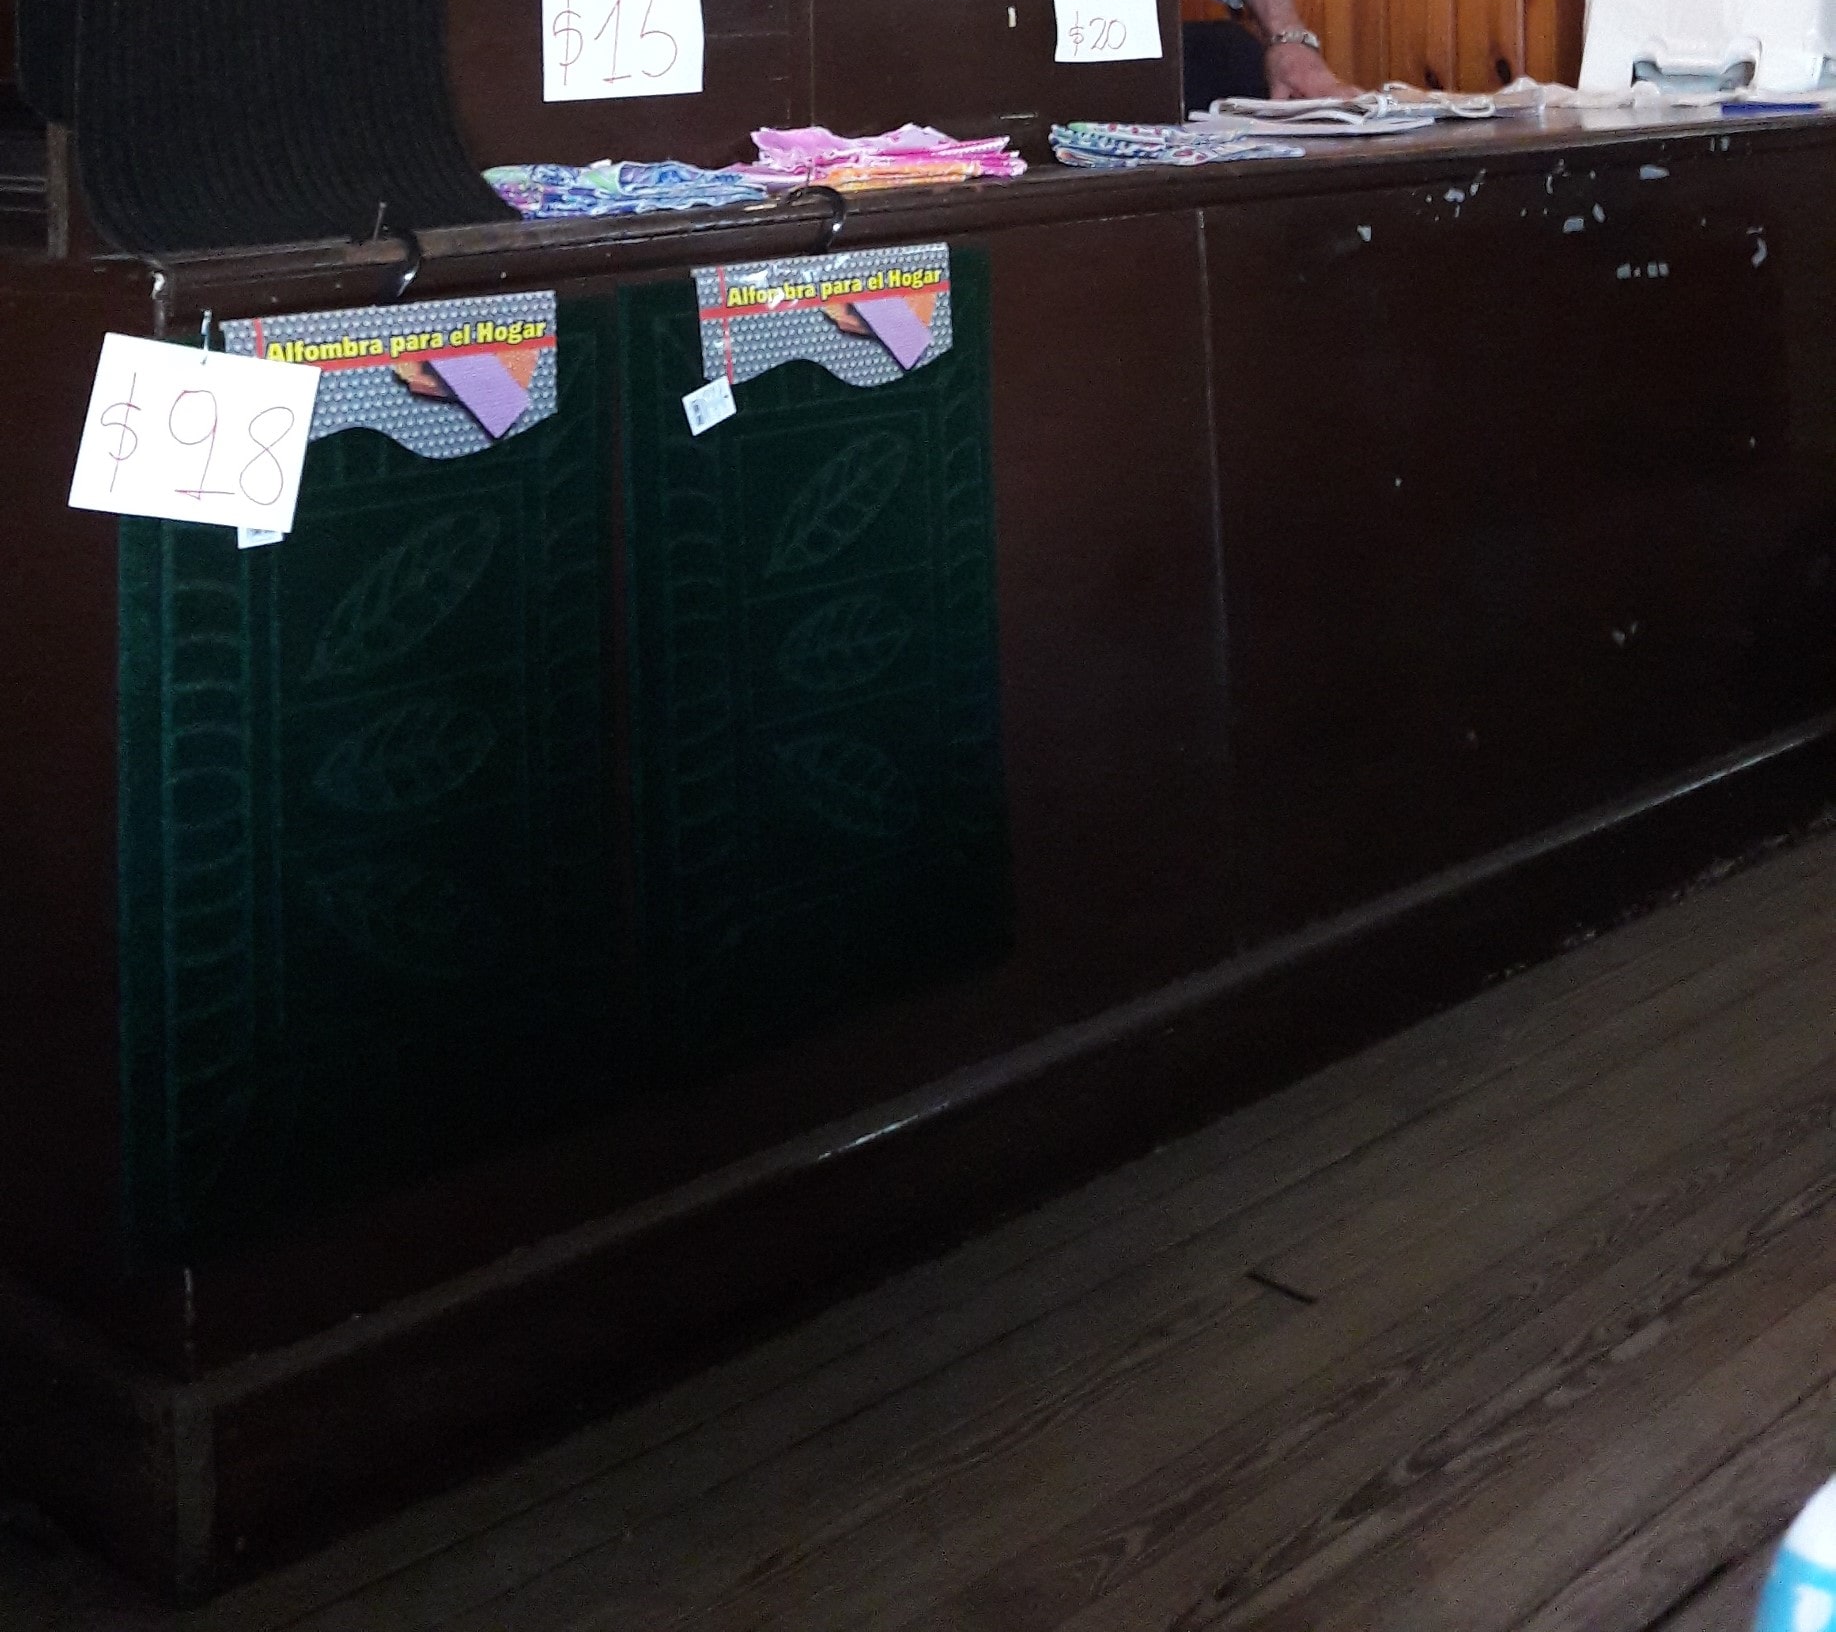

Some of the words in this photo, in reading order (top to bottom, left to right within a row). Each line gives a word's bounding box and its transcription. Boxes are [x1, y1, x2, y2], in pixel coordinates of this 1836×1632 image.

[1068, 10, 1127, 57] $20
[820, 276, 863, 302] para
[866, 273, 884, 291] el
[887, 268, 943, 289] Hogar
[266, 334, 384, 363] Alfombra
[389, 331, 443, 359] para
[449, 324, 471, 347] el
[475, 319, 547, 345] Hogar
[99, 371, 296, 506] $98
